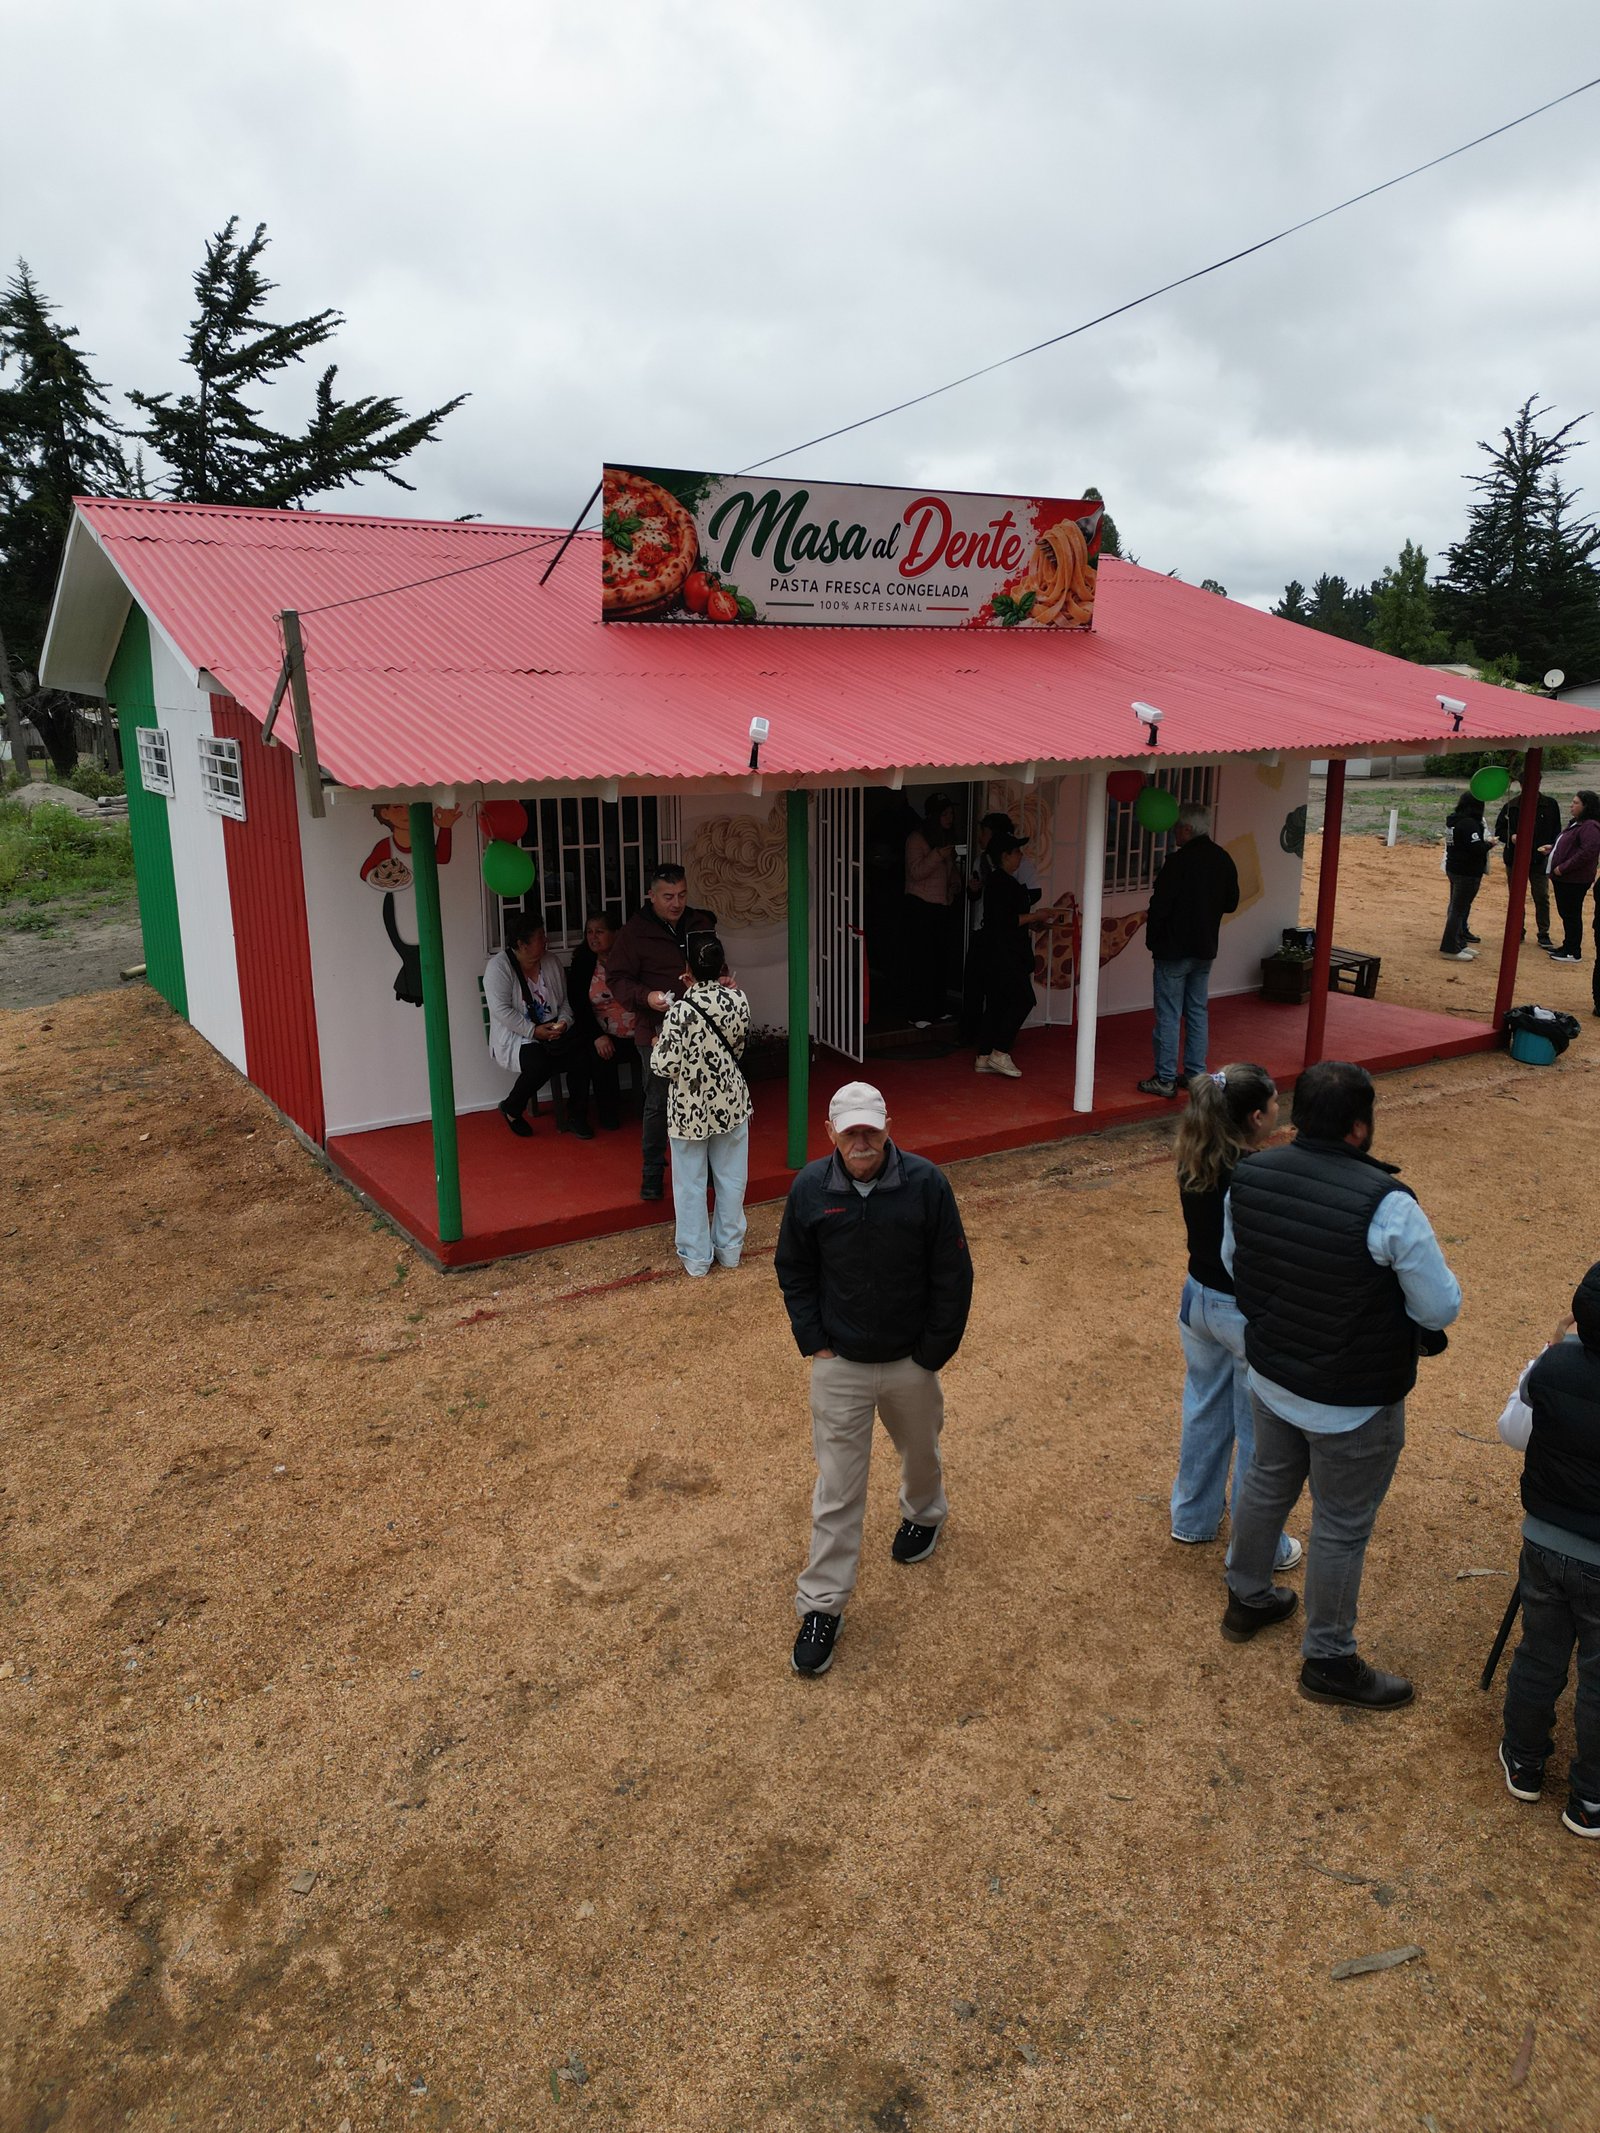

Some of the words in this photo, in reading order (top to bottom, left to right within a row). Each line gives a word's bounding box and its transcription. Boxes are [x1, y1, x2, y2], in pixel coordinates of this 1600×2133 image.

[708, 489, 872, 574] Masa
[872, 523, 901, 559] al
[899, 497, 1025, 577] Dente
[770, 578, 819, 593] PASTA
[825, 580, 880, 595] FRESCA
[886, 582, 969, 598] CONGELADA
[820, 600, 850, 611] 100%
[854, 601, 923, 613] ARTESANAL
